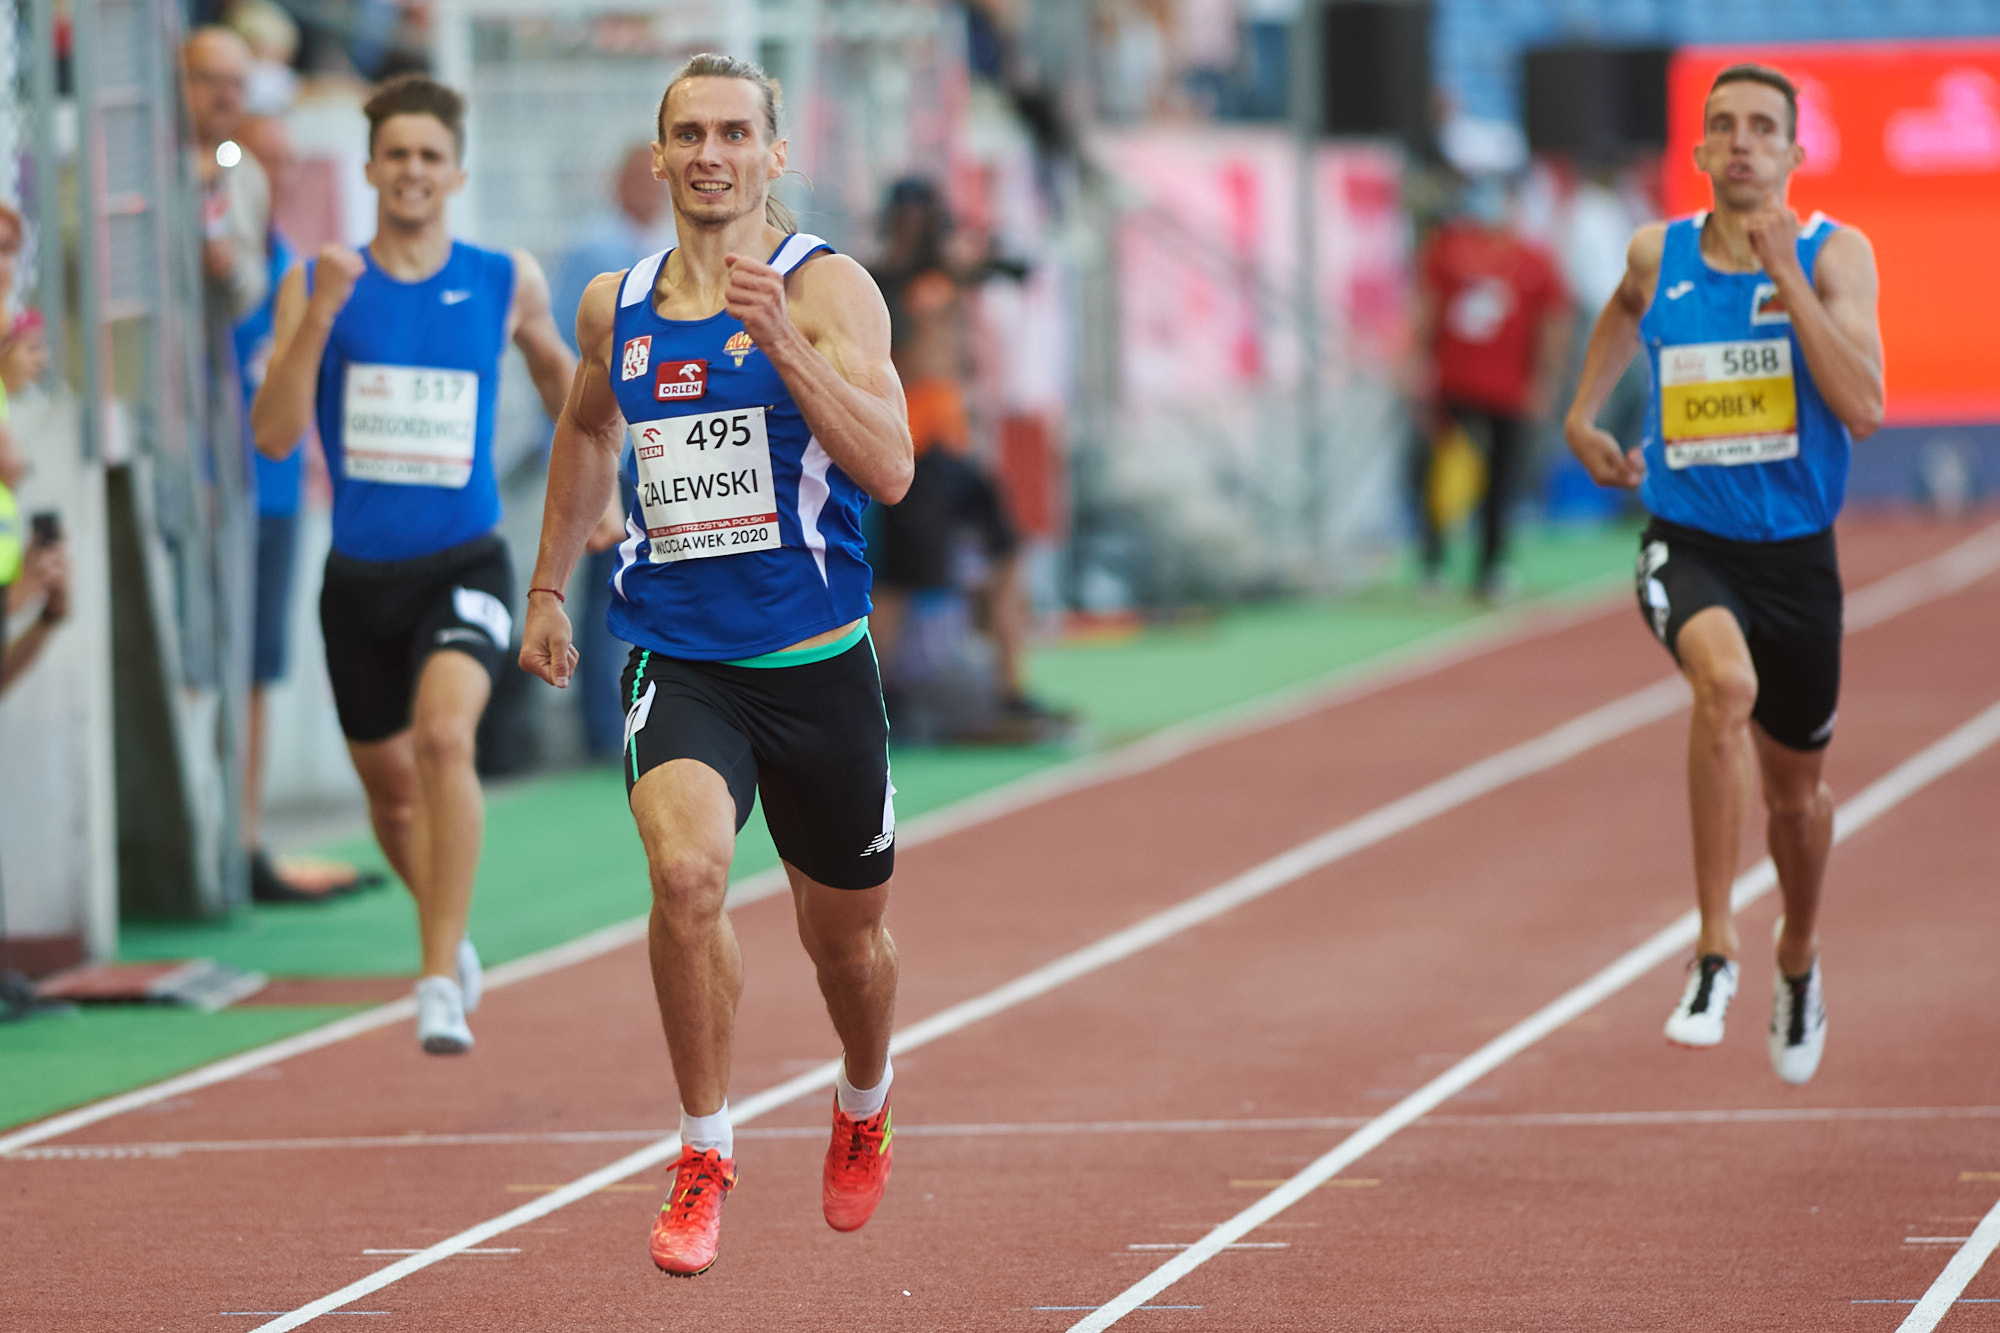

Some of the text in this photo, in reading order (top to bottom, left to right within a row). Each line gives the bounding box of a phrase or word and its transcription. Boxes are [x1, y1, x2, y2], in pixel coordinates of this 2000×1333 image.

[1722, 346, 1779, 375] 588
[662, 383, 699, 395] ORLEN
[1686, 393, 1766, 421] DOBEK
[685, 415, 751, 451] 495
[644, 468, 759, 508] ZALEWSKI
[731, 515, 766, 526] POLSKI
[654, 533, 726, 555] WŁOCŁAWEK
[731, 527, 769, 545] 2020
